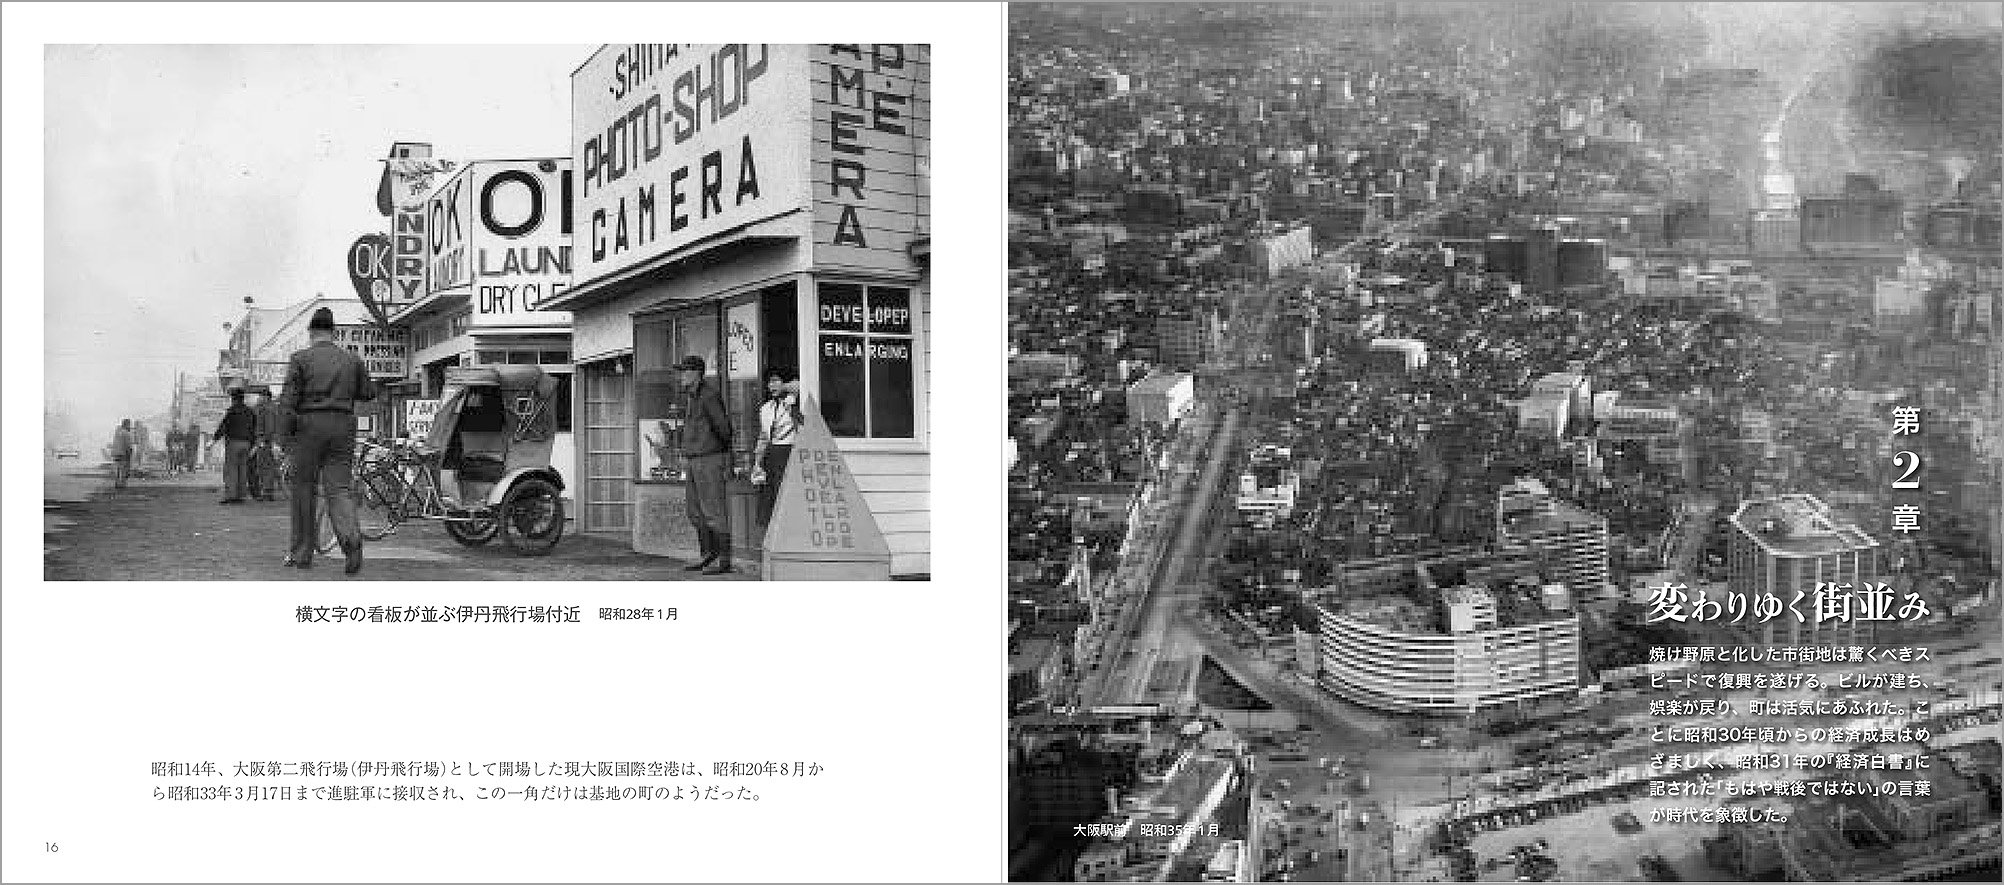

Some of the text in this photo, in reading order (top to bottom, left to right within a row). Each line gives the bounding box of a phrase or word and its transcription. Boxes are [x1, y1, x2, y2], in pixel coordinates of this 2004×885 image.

[431, 177, 463, 255] OK
[592, 134, 760, 263] CAMERA
[355, 244, 391, 279] OK
[480, 285, 518, 314] DRY
